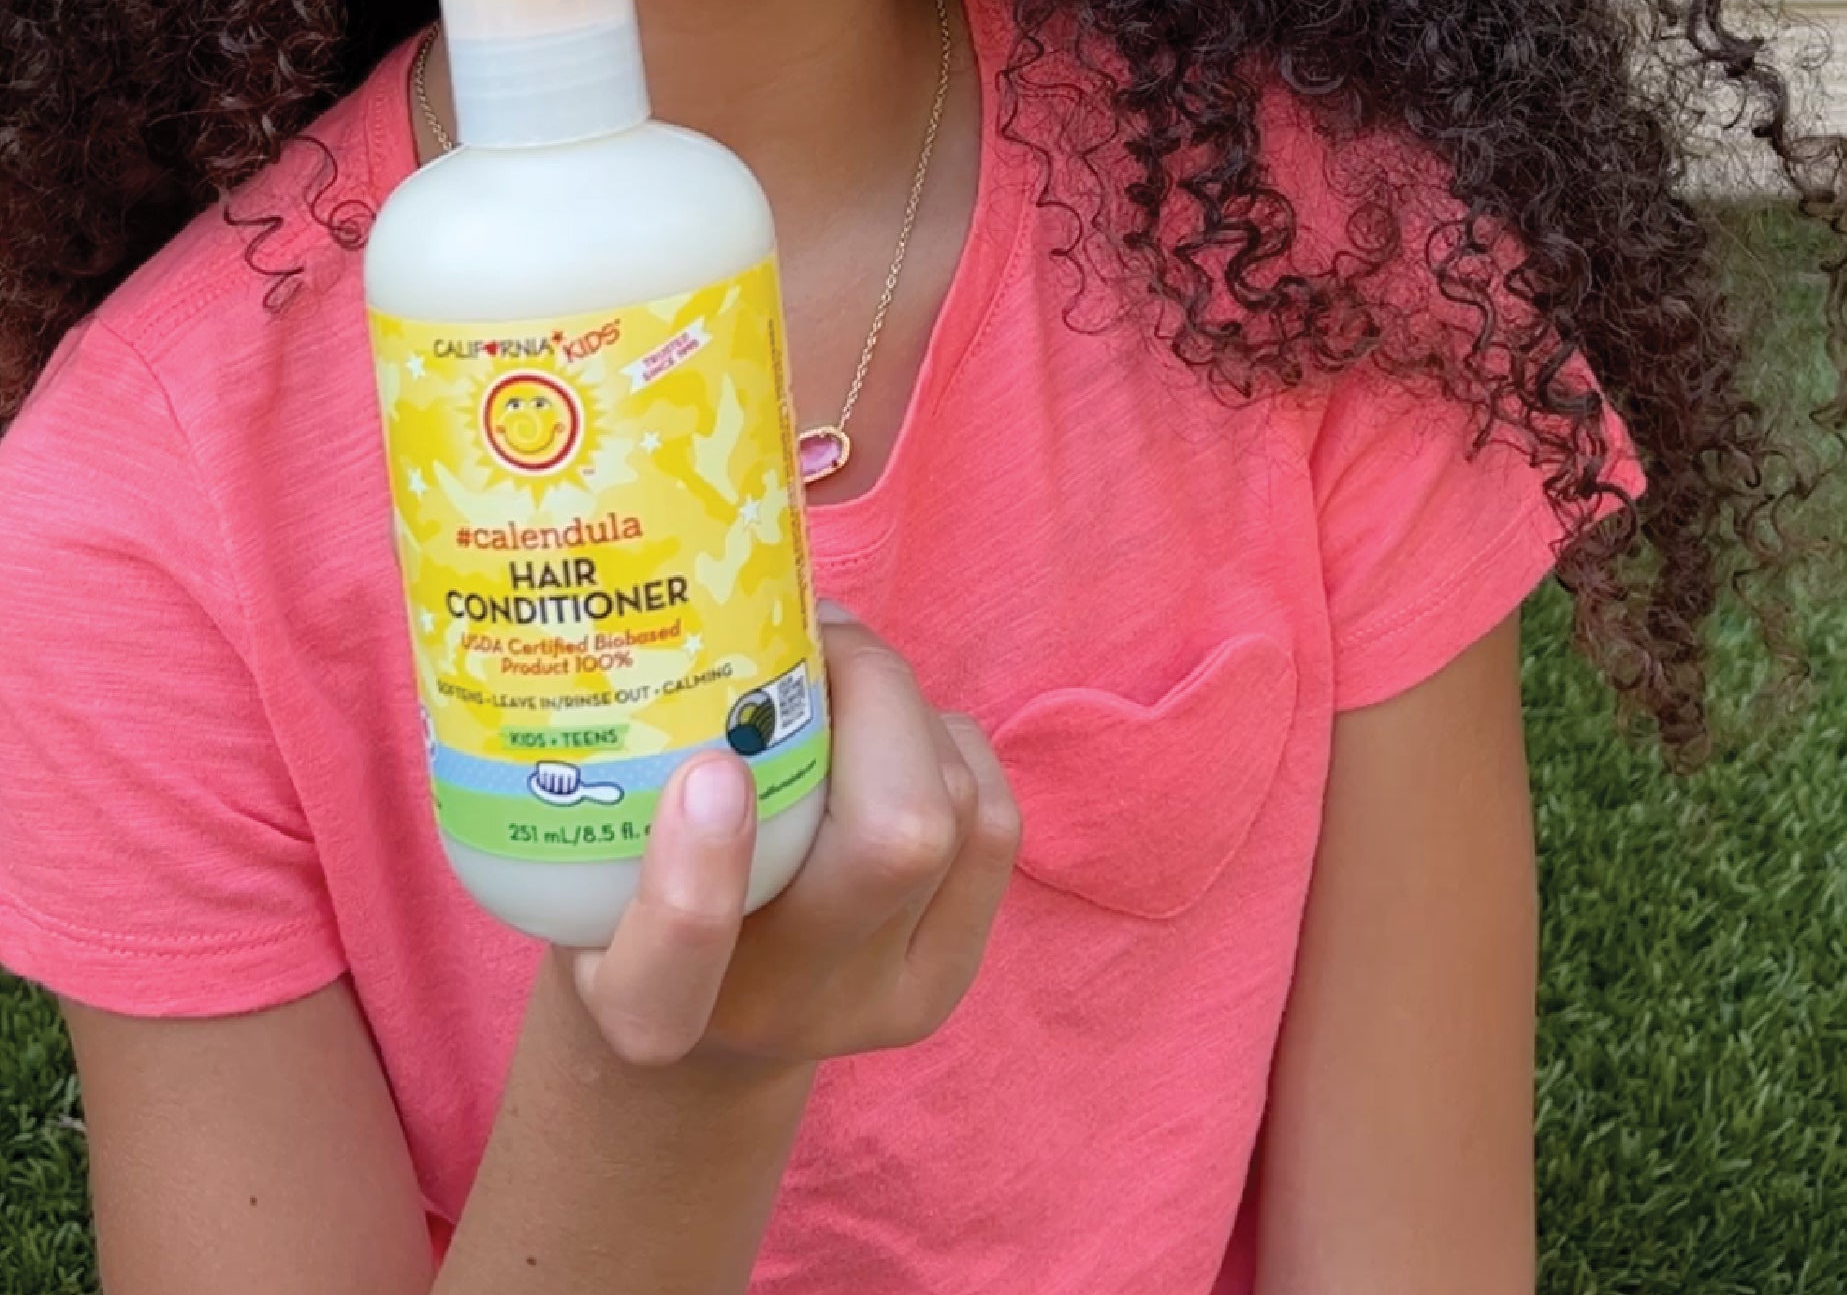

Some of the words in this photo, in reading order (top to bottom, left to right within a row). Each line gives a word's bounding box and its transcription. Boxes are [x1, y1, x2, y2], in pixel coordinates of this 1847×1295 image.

[563, 321, 621, 363] KIDS
[456, 512, 644, 550] #calendula
[508, 557, 598, 590] HAIR
[446, 575, 689, 625] CONDITIONER
[461, 632, 503, 652] USDA
[507, 635, 589, 657] Certified
[594, 619, 682, 651] Biobased
[500, 656, 570, 676] Product
[575, 649, 634, 674] 100%
[492, 693, 537, 709] LEAVE
[614, 685, 651, 705] OUT
[662, 661, 733, 695] CALMING
[509, 730, 547, 748] KIDS
[561, 728, 618, 748] TEENS
[508, 822, 539, 843] 251
[543, 823, 616, 847] mL/8.5
